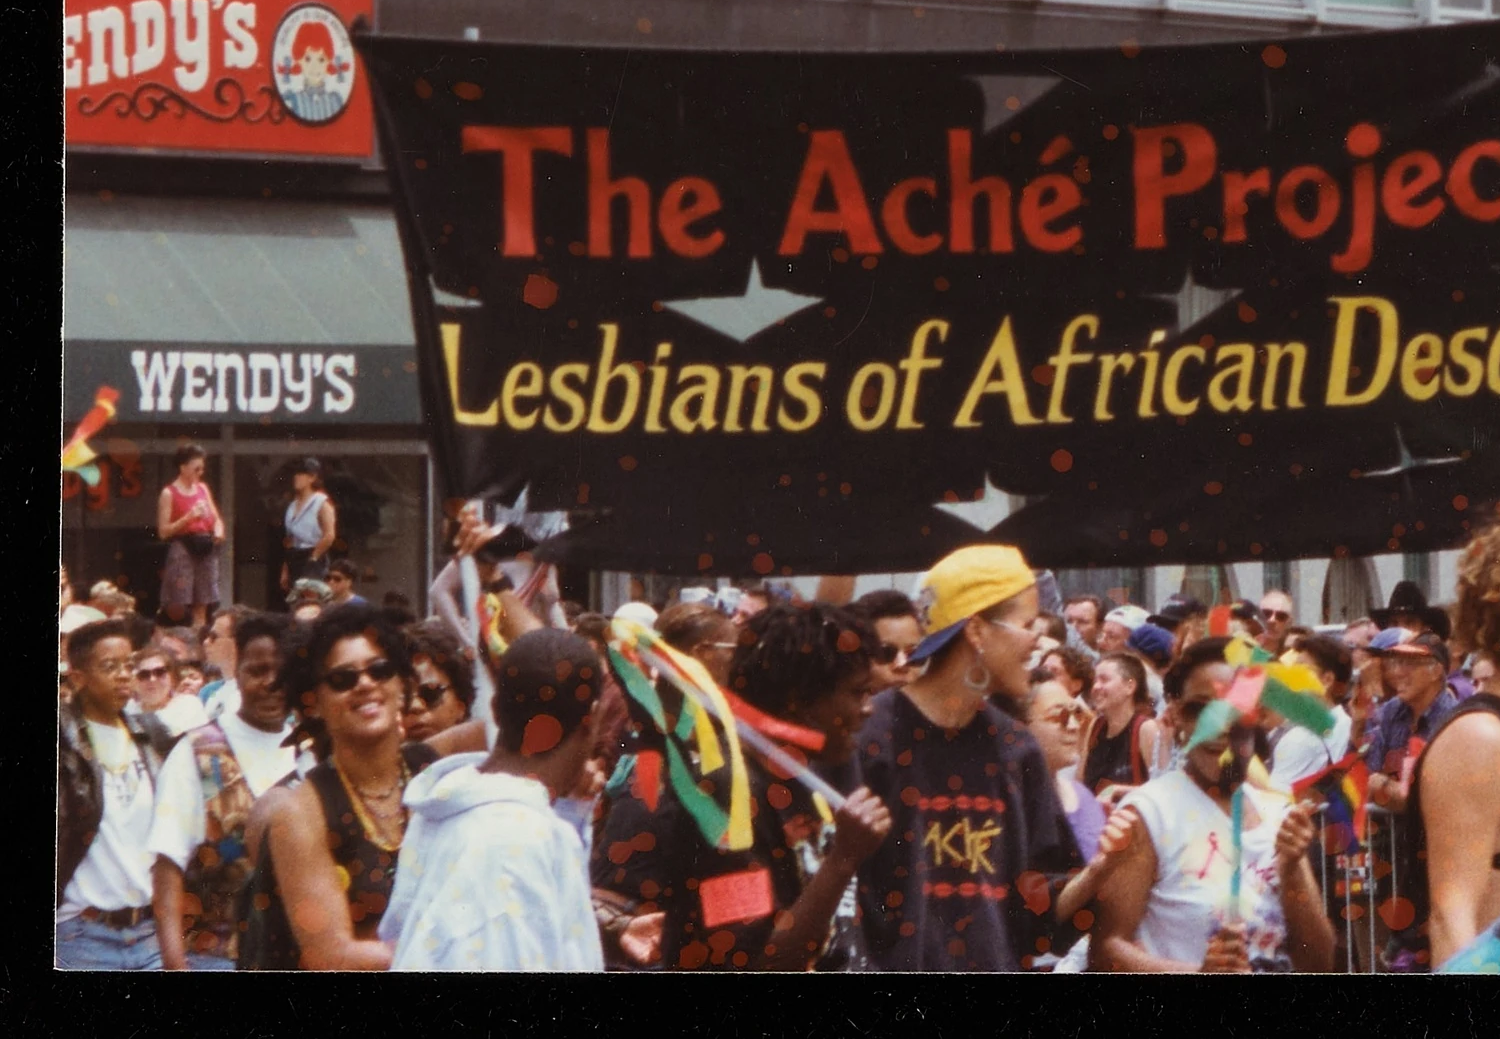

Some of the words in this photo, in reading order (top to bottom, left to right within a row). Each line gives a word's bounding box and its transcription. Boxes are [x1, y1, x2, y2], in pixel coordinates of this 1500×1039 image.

[461, 125, 726, 259] The
[777, 127, 1086, 256] Aché
[131, 349, 357, 415] WENDY'S
[440, 321, 827, 435] Lesbians
[845, 318, 951, 431] of
[952, 313, 1306, 429] African
